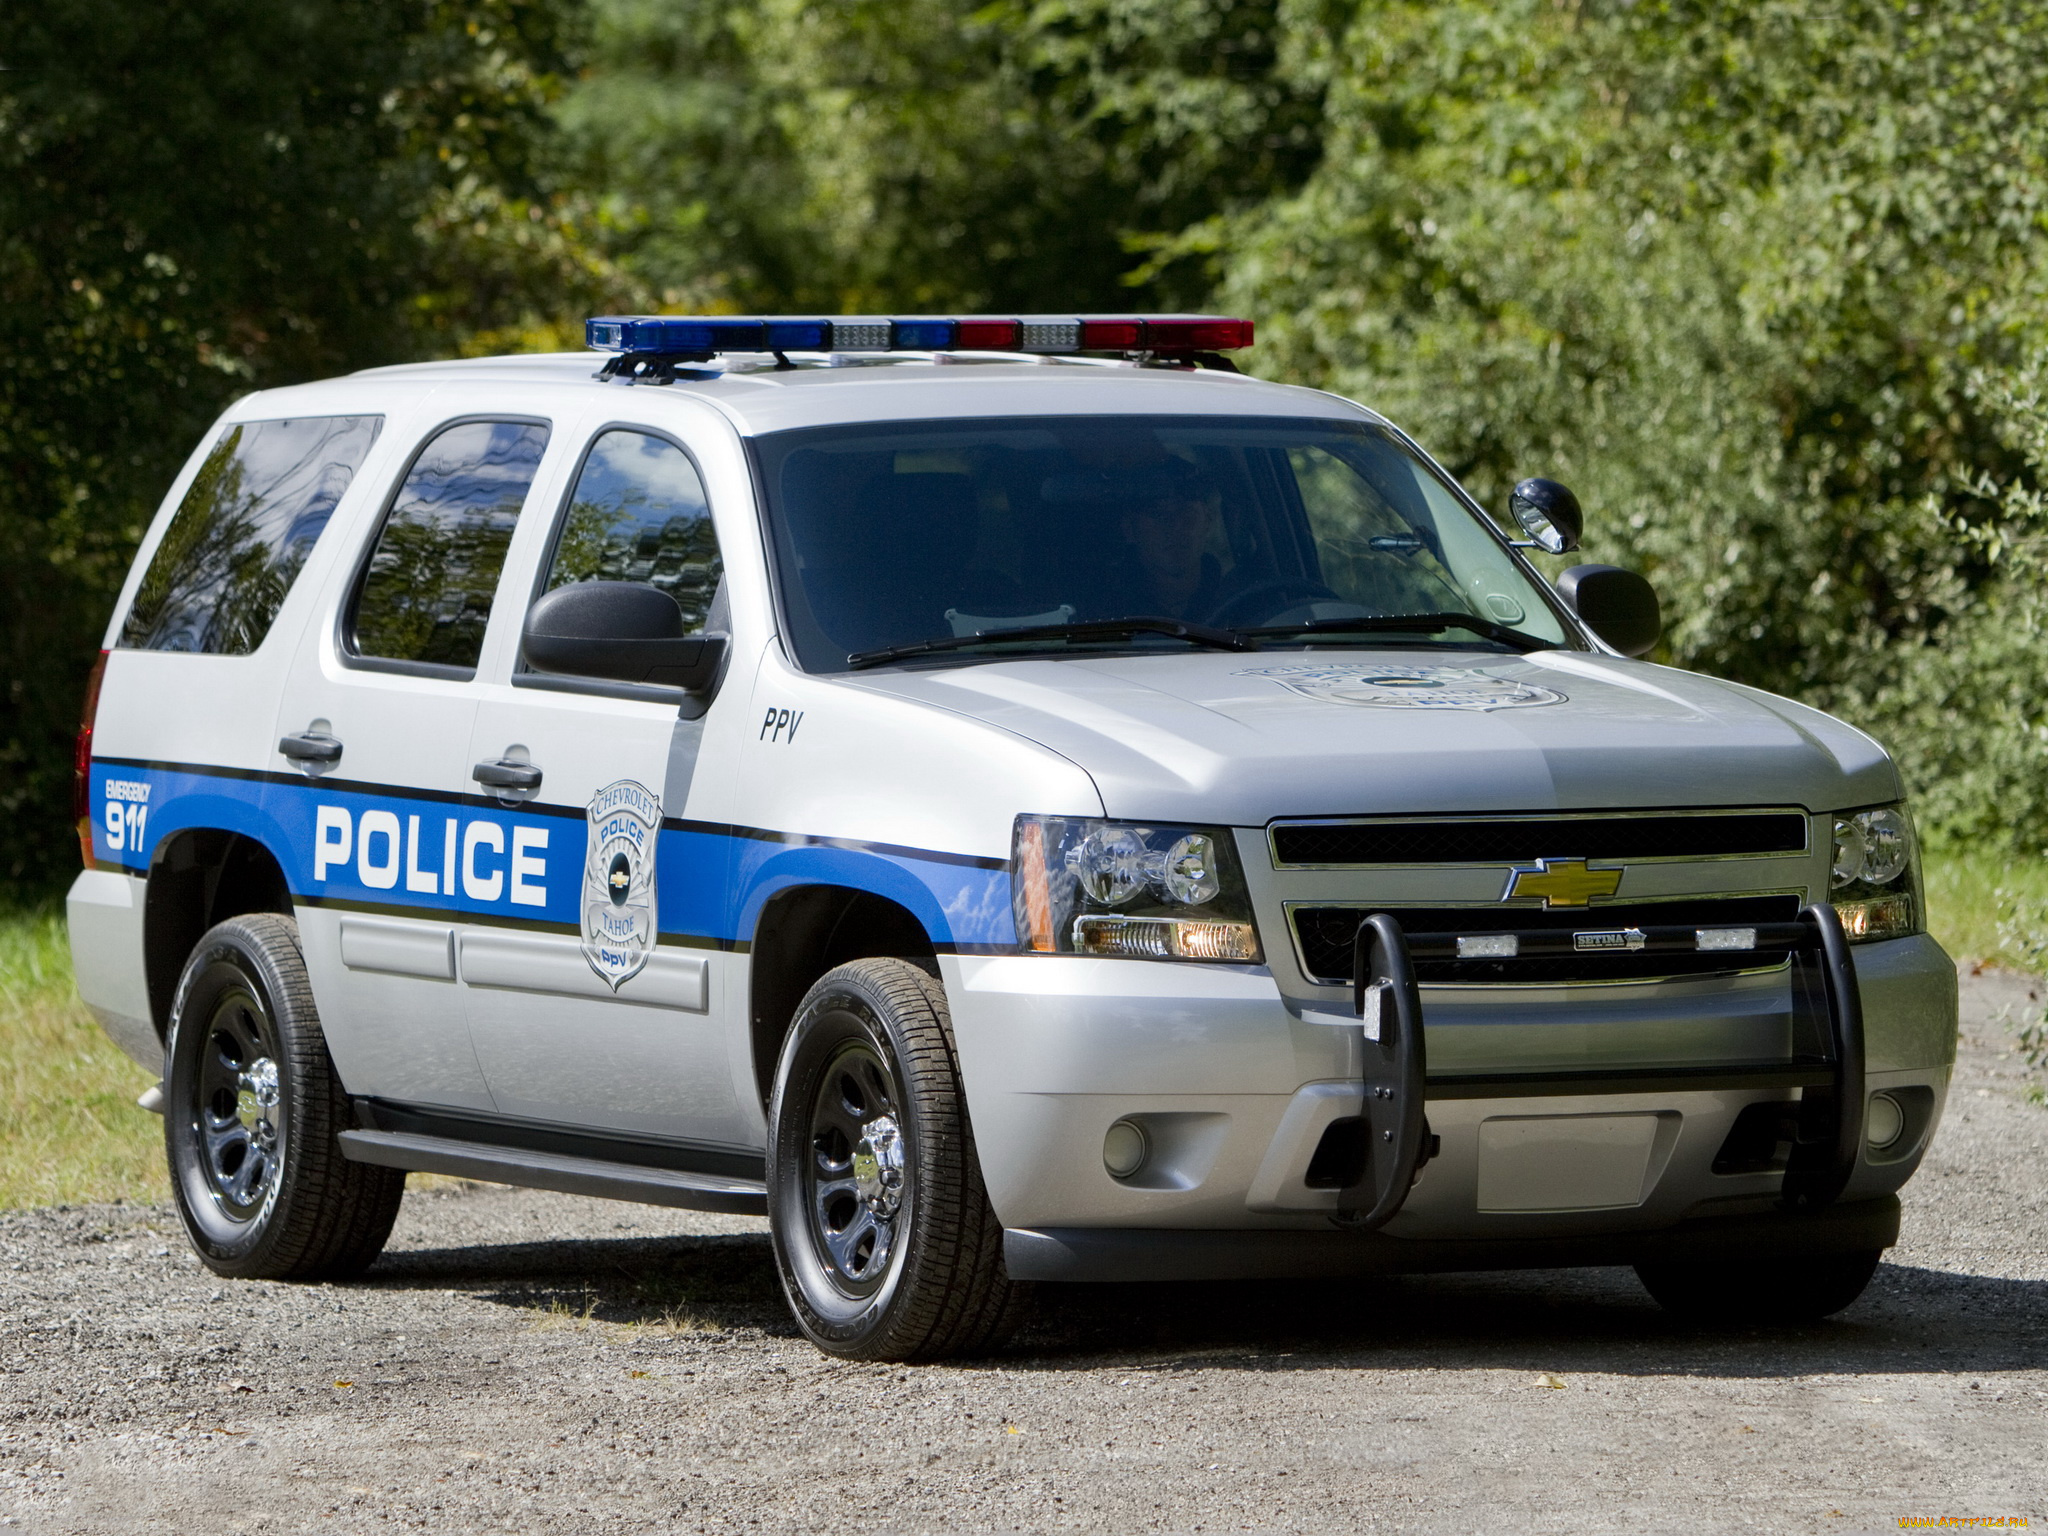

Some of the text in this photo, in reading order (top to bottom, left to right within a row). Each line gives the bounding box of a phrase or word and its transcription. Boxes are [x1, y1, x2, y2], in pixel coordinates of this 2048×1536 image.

[760, 706, 804, 745] PPV
[596, 787, 655, 822] CHEVROLET
[105, 801, 148, 853] 911
[600, 818, 645, 848] POLICE
[314, 804, 549, 907] POLICE
[602, 912, 635, 937] TAHOE
[1577, 934, 1625, 945] SETINA
[601, 948, 628, 968] PPV
